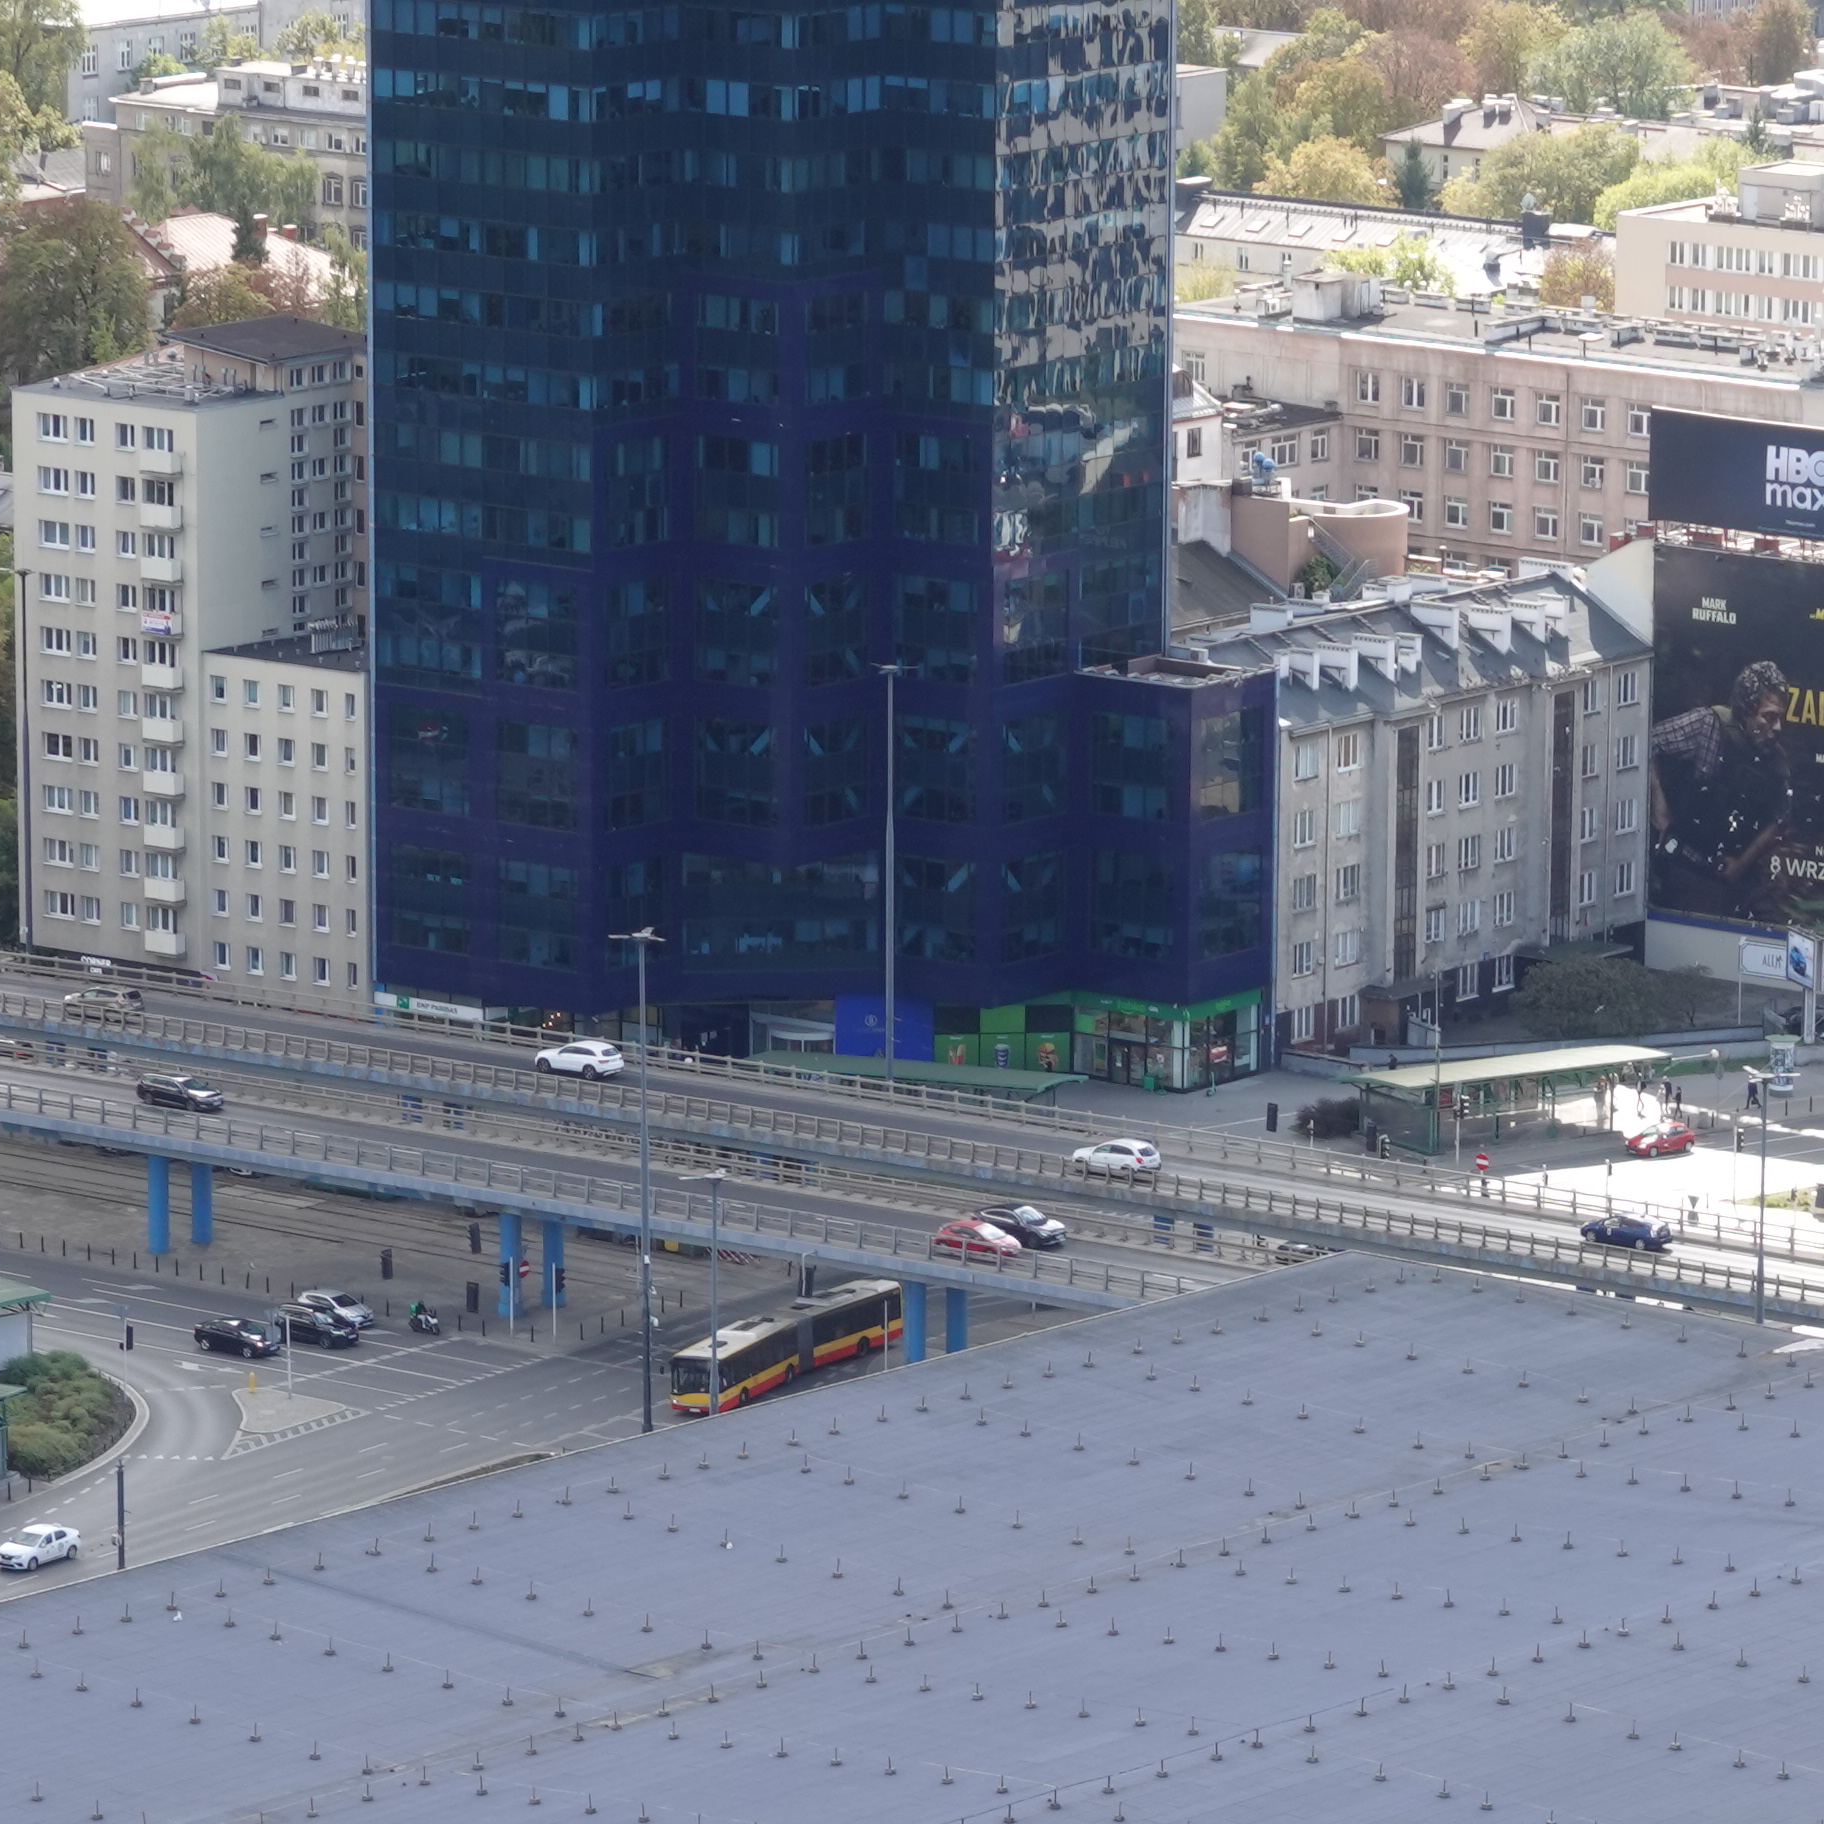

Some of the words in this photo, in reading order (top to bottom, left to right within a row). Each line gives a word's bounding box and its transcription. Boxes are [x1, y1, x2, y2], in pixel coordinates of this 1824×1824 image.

[1701, 597, 1727, 610] MARK
[1692, 607, 1737, 625] RUFFALO
[1770, 855, 1781, 874] 8
